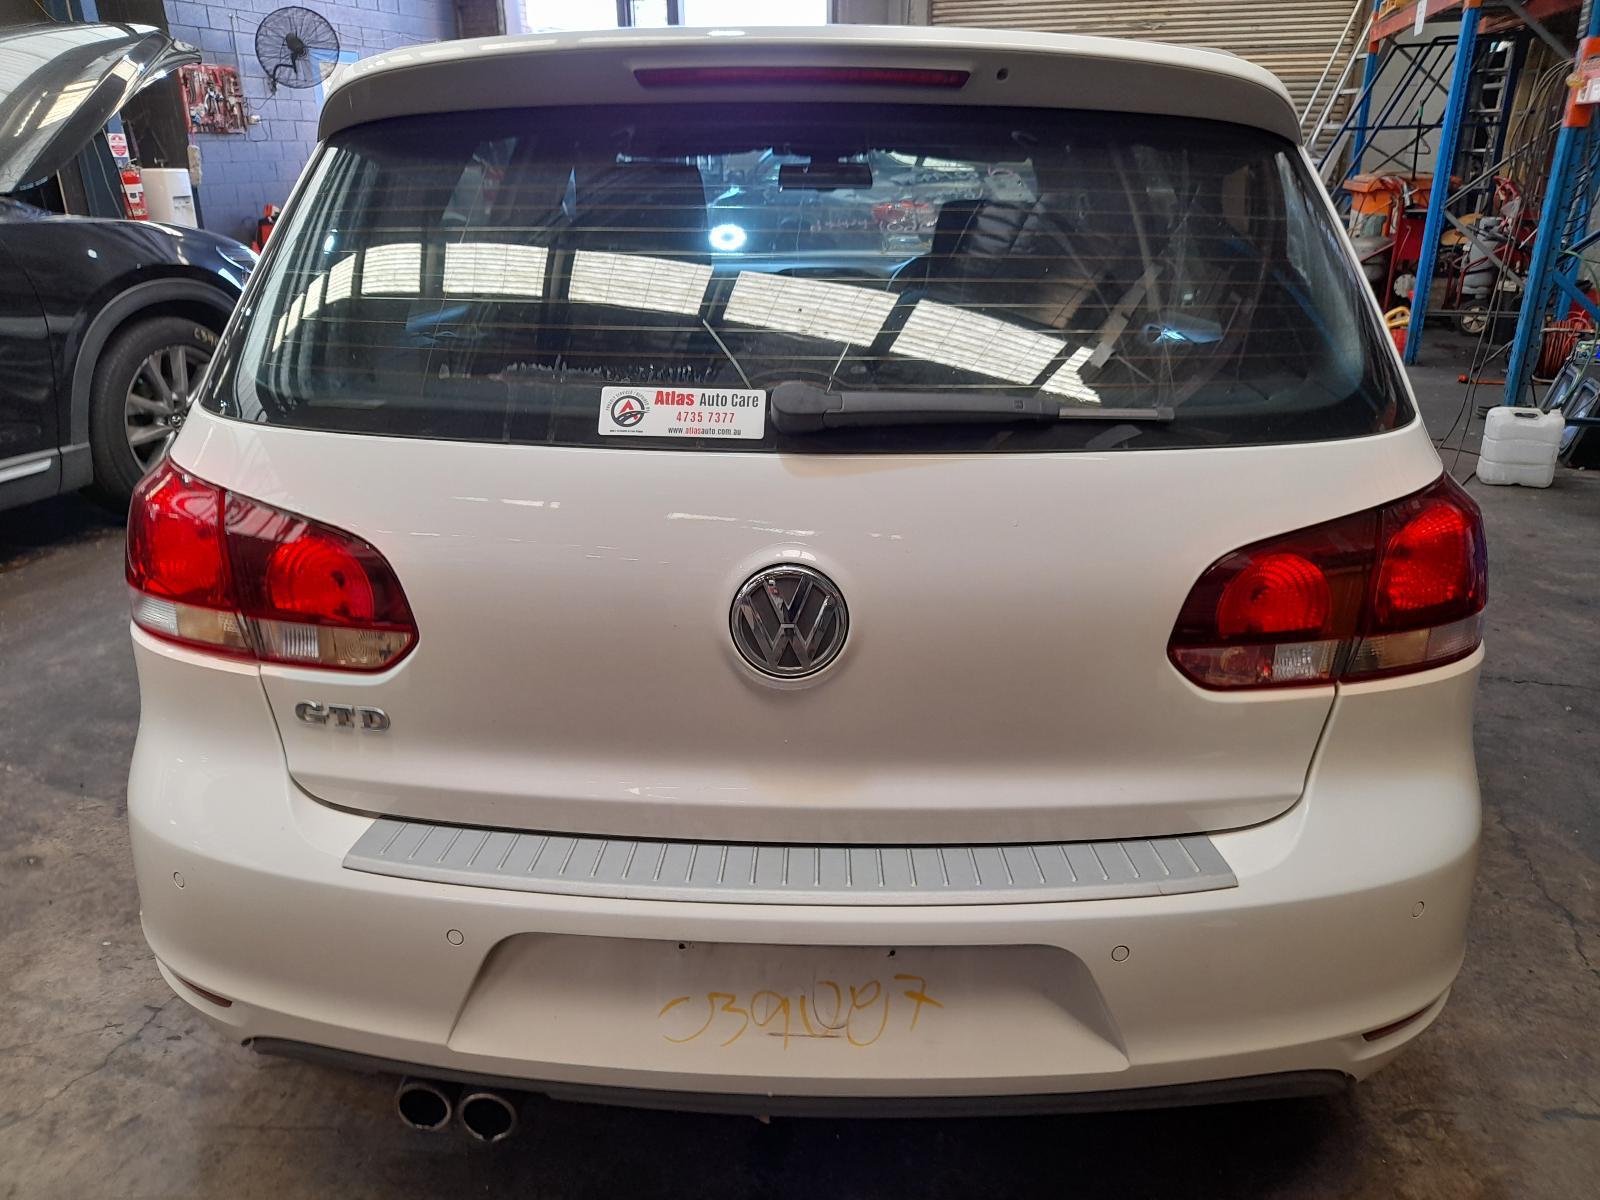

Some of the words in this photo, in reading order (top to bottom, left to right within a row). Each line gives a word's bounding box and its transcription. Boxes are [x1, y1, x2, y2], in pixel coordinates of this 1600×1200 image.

[654, 390, 695, 406] Atlas
[699, 392, 728, 407] Auto
[731, 393, 759, 408] Care
[676, 411, 703, 422] 4735
[708, 412, 735, 423] 7377
[667, 427, 742, 436] www.atlasauto.com.au
[295, 699, 391, 732] GTD
